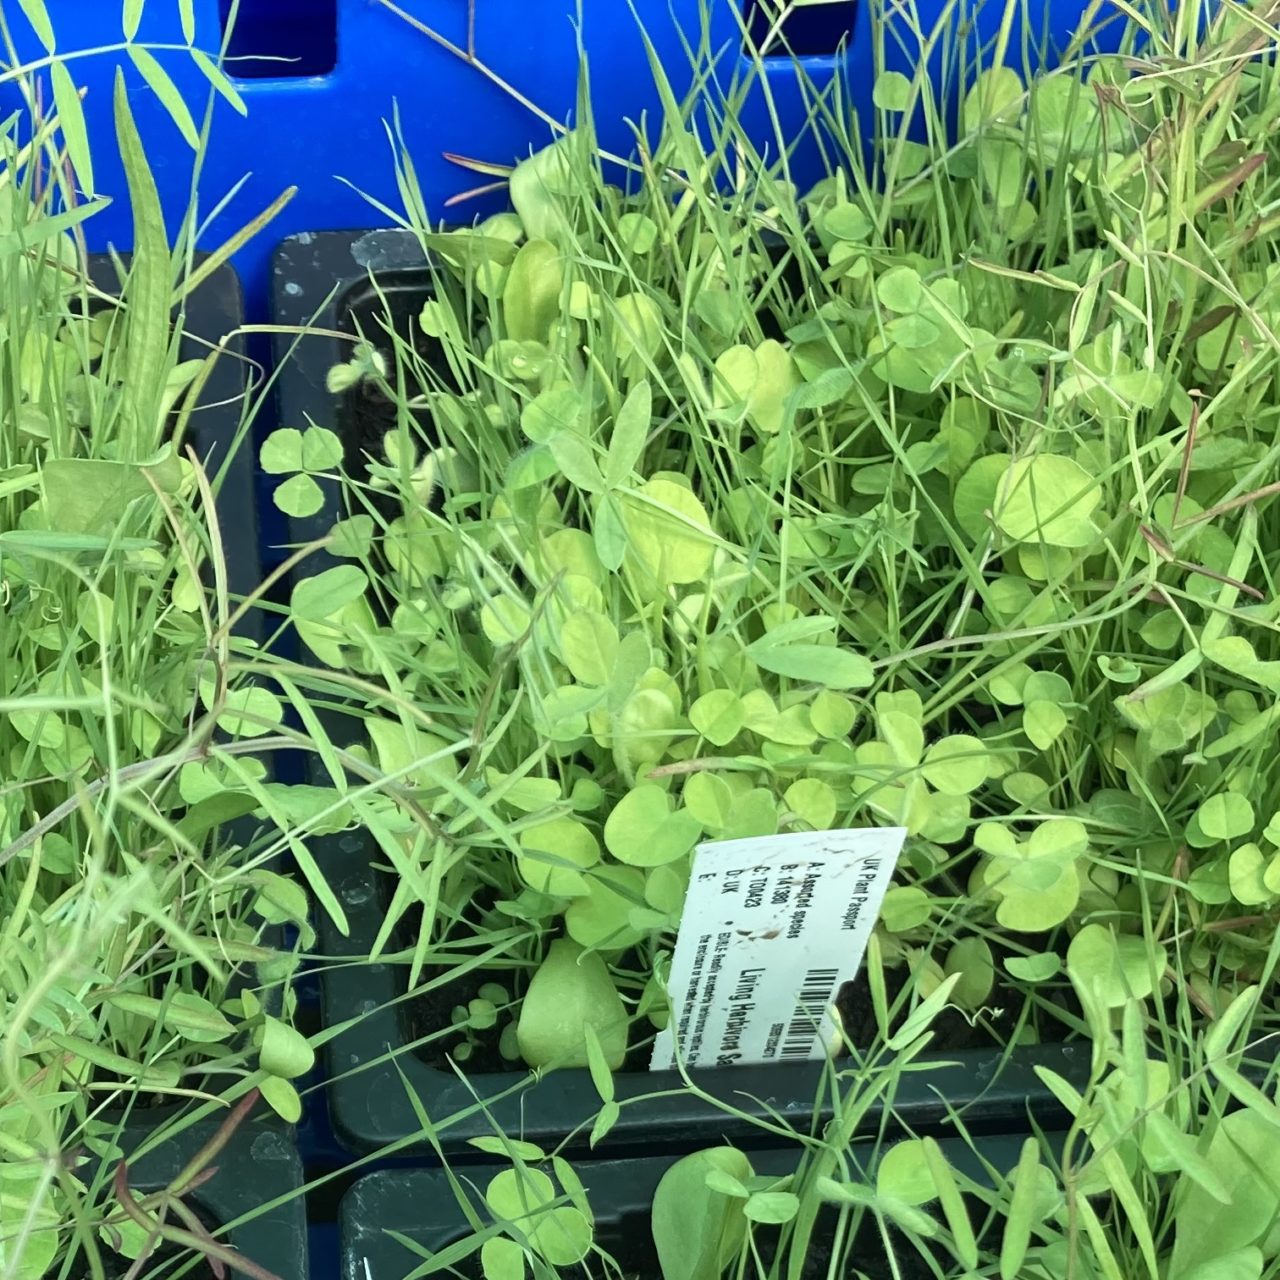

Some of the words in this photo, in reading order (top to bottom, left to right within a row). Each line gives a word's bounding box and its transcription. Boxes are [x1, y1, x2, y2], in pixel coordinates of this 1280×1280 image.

[751, 865, 771, 876] C:
[778, 863, 798, 873] B:
[806, 860, 825, 871] A:
[860, 857, 881, 871] UK
[697, 872, 716, 882] E:
[724, 869, 743, 879] D:
[720, 880, 740, 894] UK
[795, 873, 822, 908] Assorted
[853, 873, 876, 894] Plant
[840, 896, 868, 930] Passport
[786, 910, 807, 939] species
[728, 967, 766, 1001] Living
[720, 1002, 756, 1051] Herbivore
